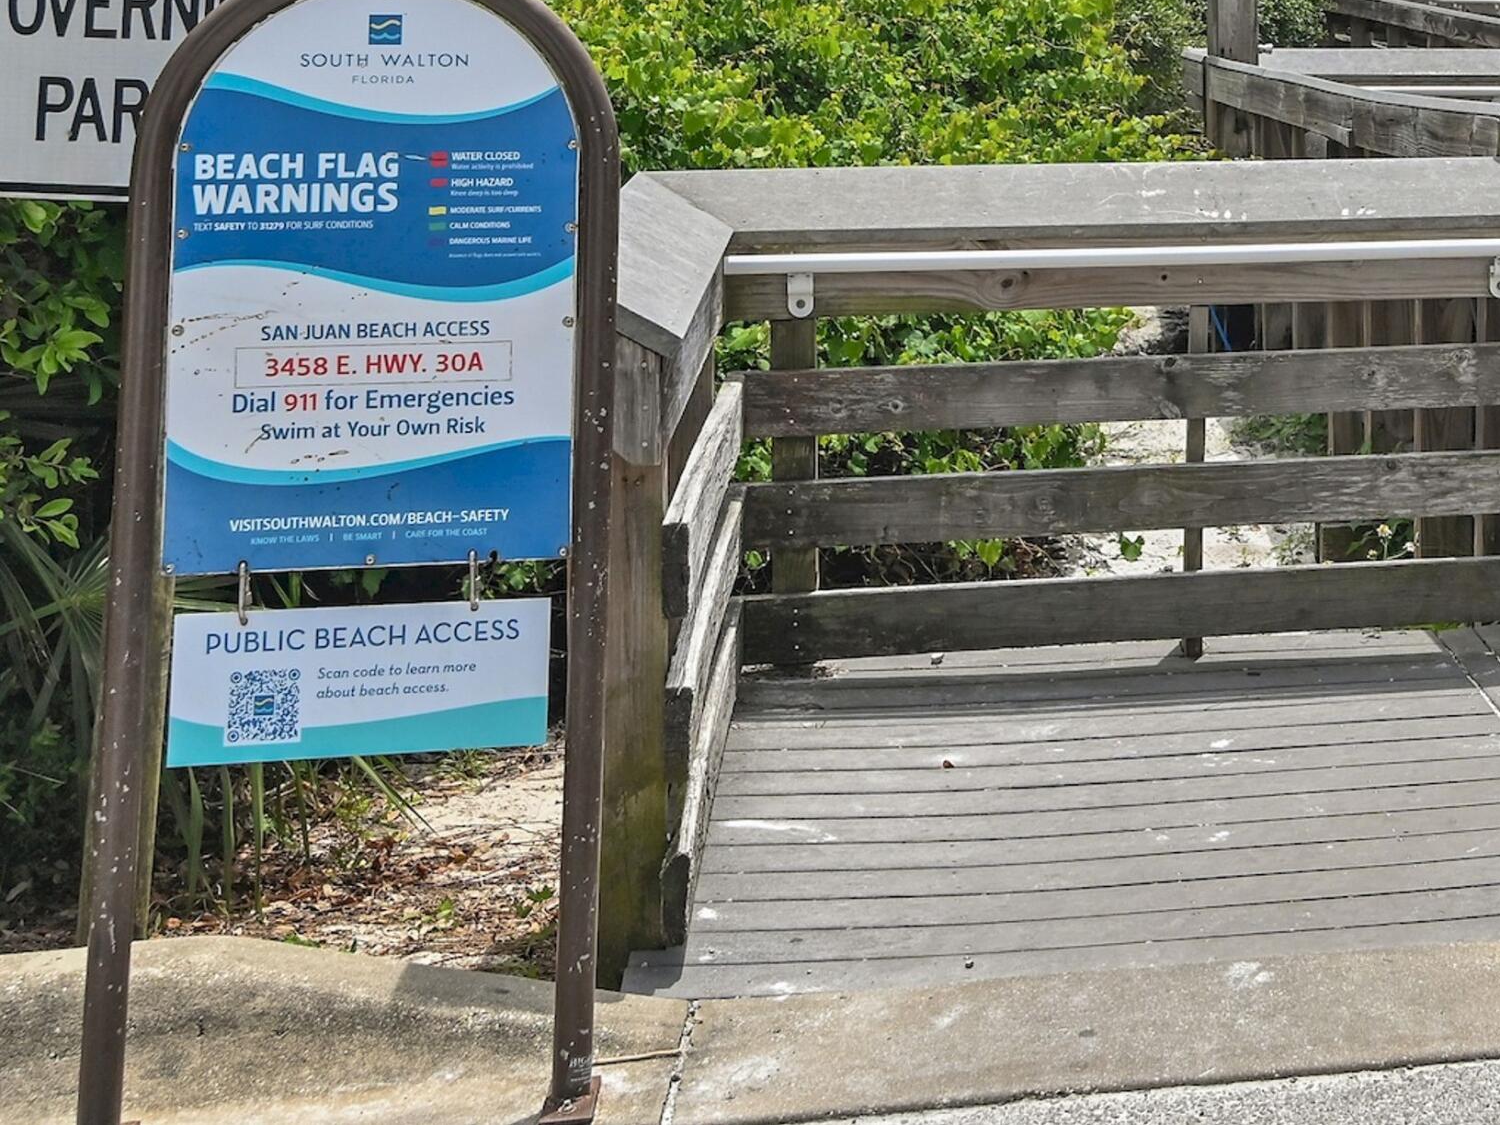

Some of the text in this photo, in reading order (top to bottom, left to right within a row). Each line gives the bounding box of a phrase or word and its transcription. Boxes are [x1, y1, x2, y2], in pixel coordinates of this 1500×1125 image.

[299, 53, 470, 68] SOUTH WALTON
[351, 74, 415, 84] FLORIDA
[451, 151, 521, 161] WATER CLOSED
[194, 151, 400, 180] BEACH FLAG
[451, 177, 514, 187] HIGH HAZARD
[192, 182, 399, 215] WARNINGS
[449, 206, 487, 214] MODERATE
[193, 220, 374, 232] TEXT SAFETY TO 31279 FOR SURF CONDITIONS
[449, 221, 511, 229] CALM CONDITIONS
[449, 236, 532, 245] DANGEROUS MARINE LIFE
[260, 320, 491, 341] SAN JUAN BEACH ACCESS
[265, 351, 484, 377] 3458 E. HWY. 30A
[232, 385, 515, 414] Dial 911 for Emergencies
[260, 416, 486, 441] Swim at Your Own Risk
[229, 508, 510, 533] VISITSOUTHWALTON.COM/BEACH-SAFETY
[250, 534, 320, 546] KNOW THE LAWS
[343, 531, 383, 542] BE SMART
[405, 527, 488, 539] CARE FOR THE COAST
[205, 618, 520, 655] PUBLIC BEACH ACCESS
[317, 661, 477, 680] Scan code to learn more
[315, 683, 450, 699] about beach access.
